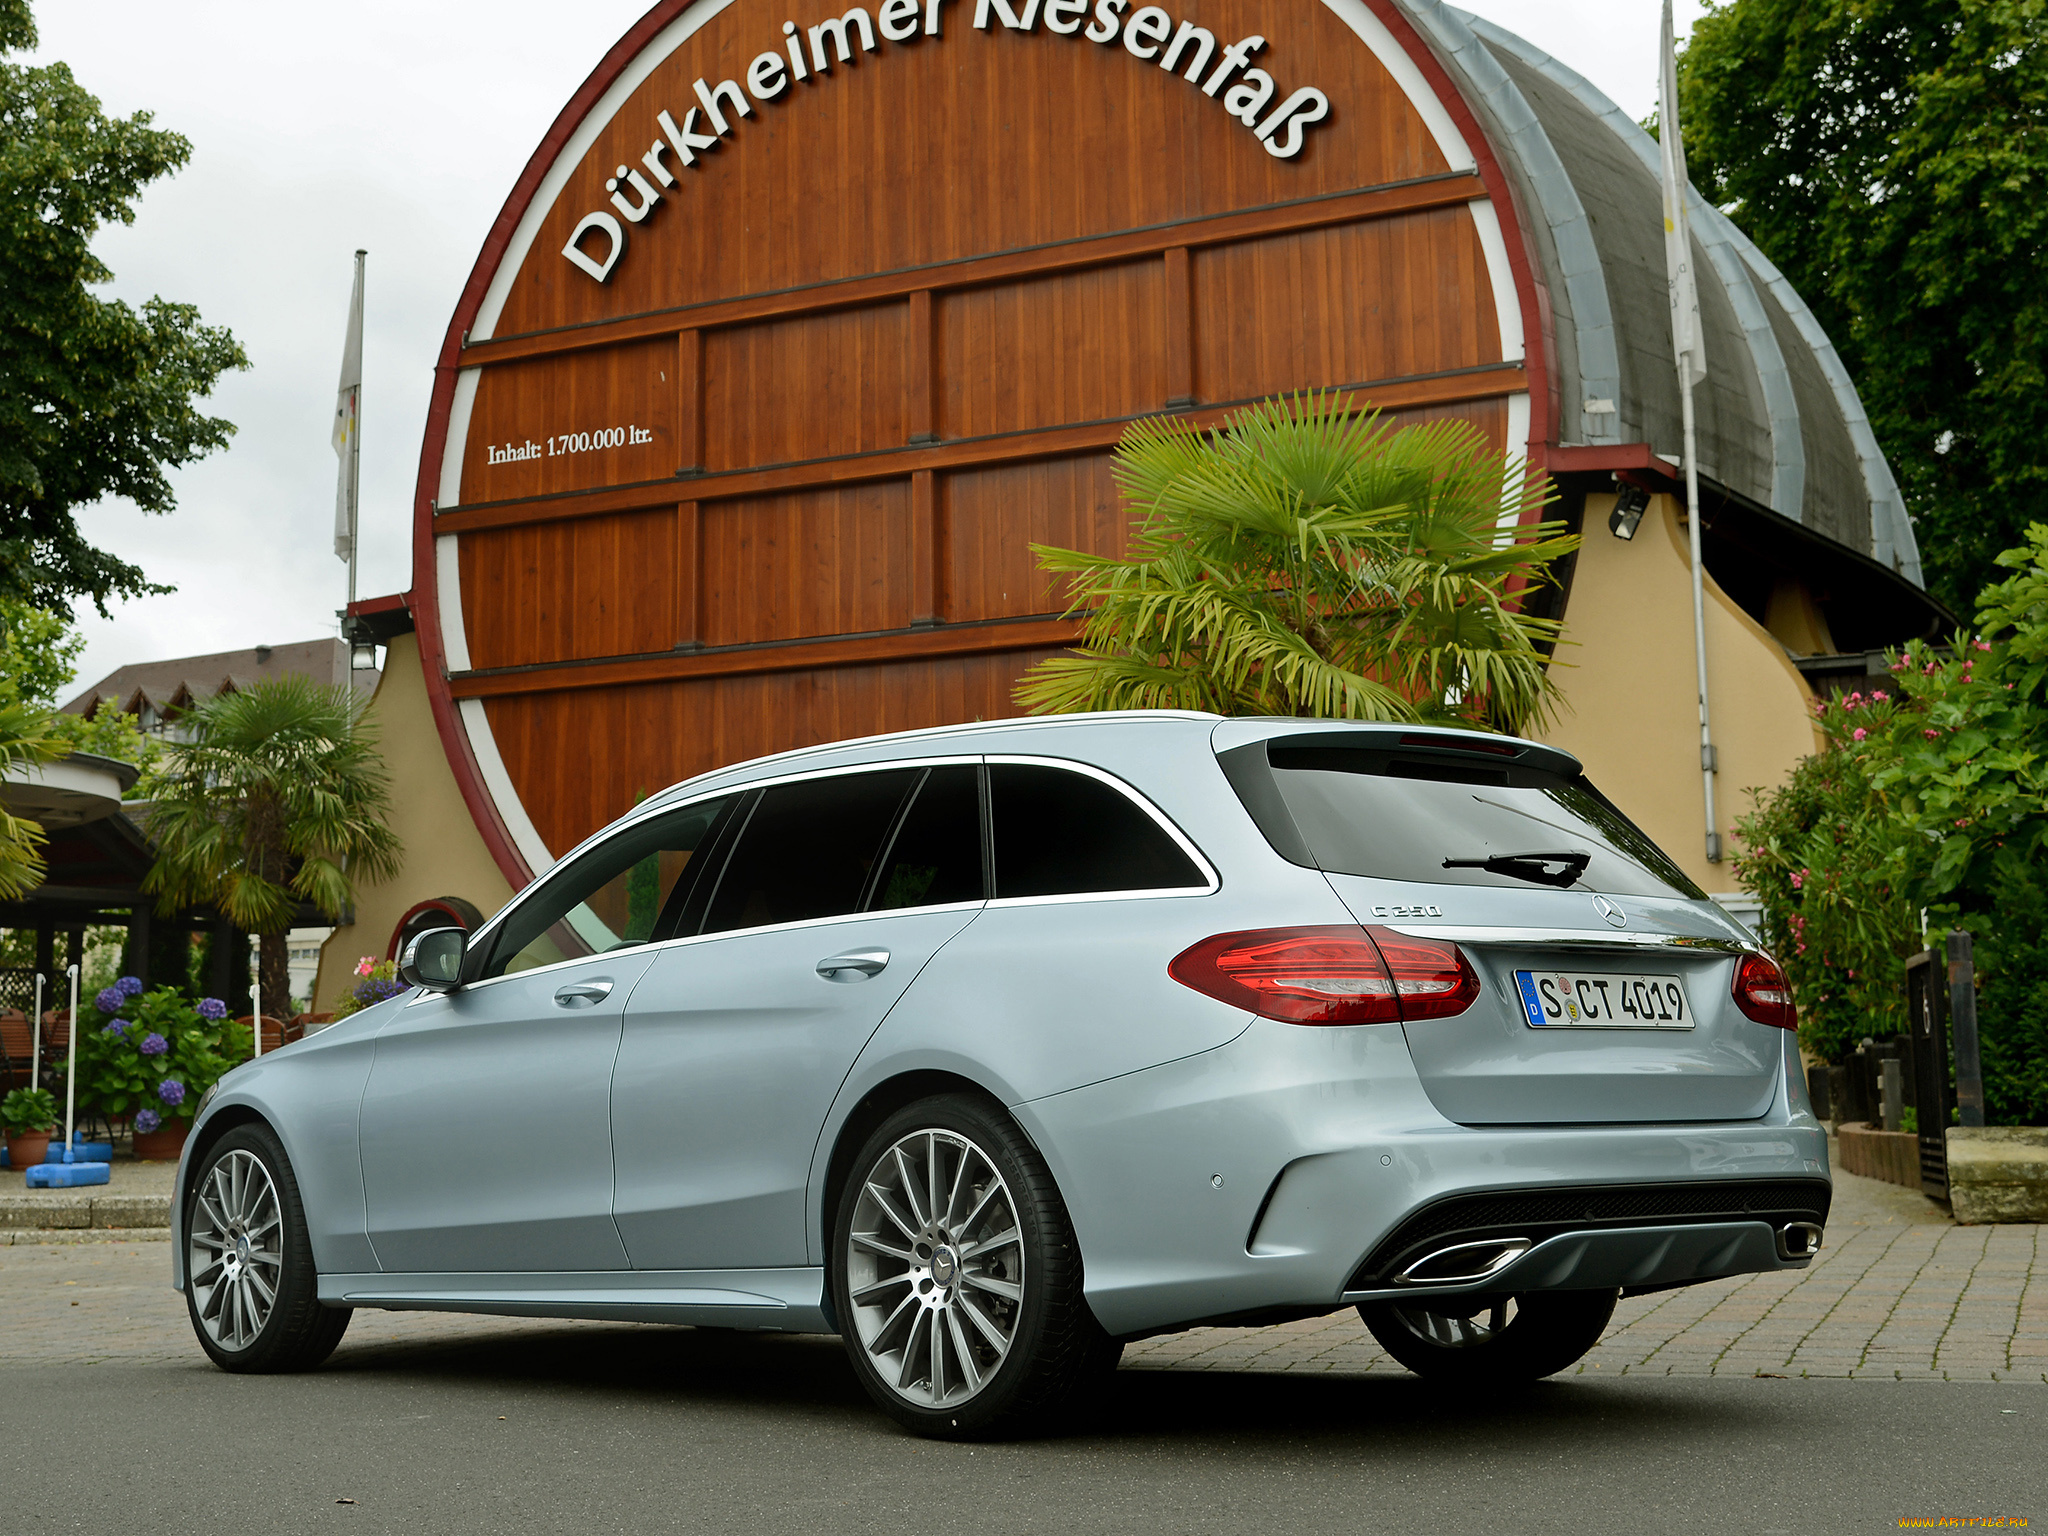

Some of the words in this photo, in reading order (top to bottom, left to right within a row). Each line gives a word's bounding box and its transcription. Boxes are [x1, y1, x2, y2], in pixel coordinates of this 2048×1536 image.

[560, 0, 944, 283] Dürkheimer
[487, 440, 542, 465] Inhalt:
[547, 426, 625, 457] 1.700.000
[628, 424, 653, 445] ltr.
[1370, 905, 1389, 918] C
[1391, 905, 1443, 918] 250
[1530, 1003, 1539, 1016] D
[1539, 978, 1562, 1019] S
[1575, 979, 1614, 1020] CT
[1621, 980, 1683, 1021] 4019
